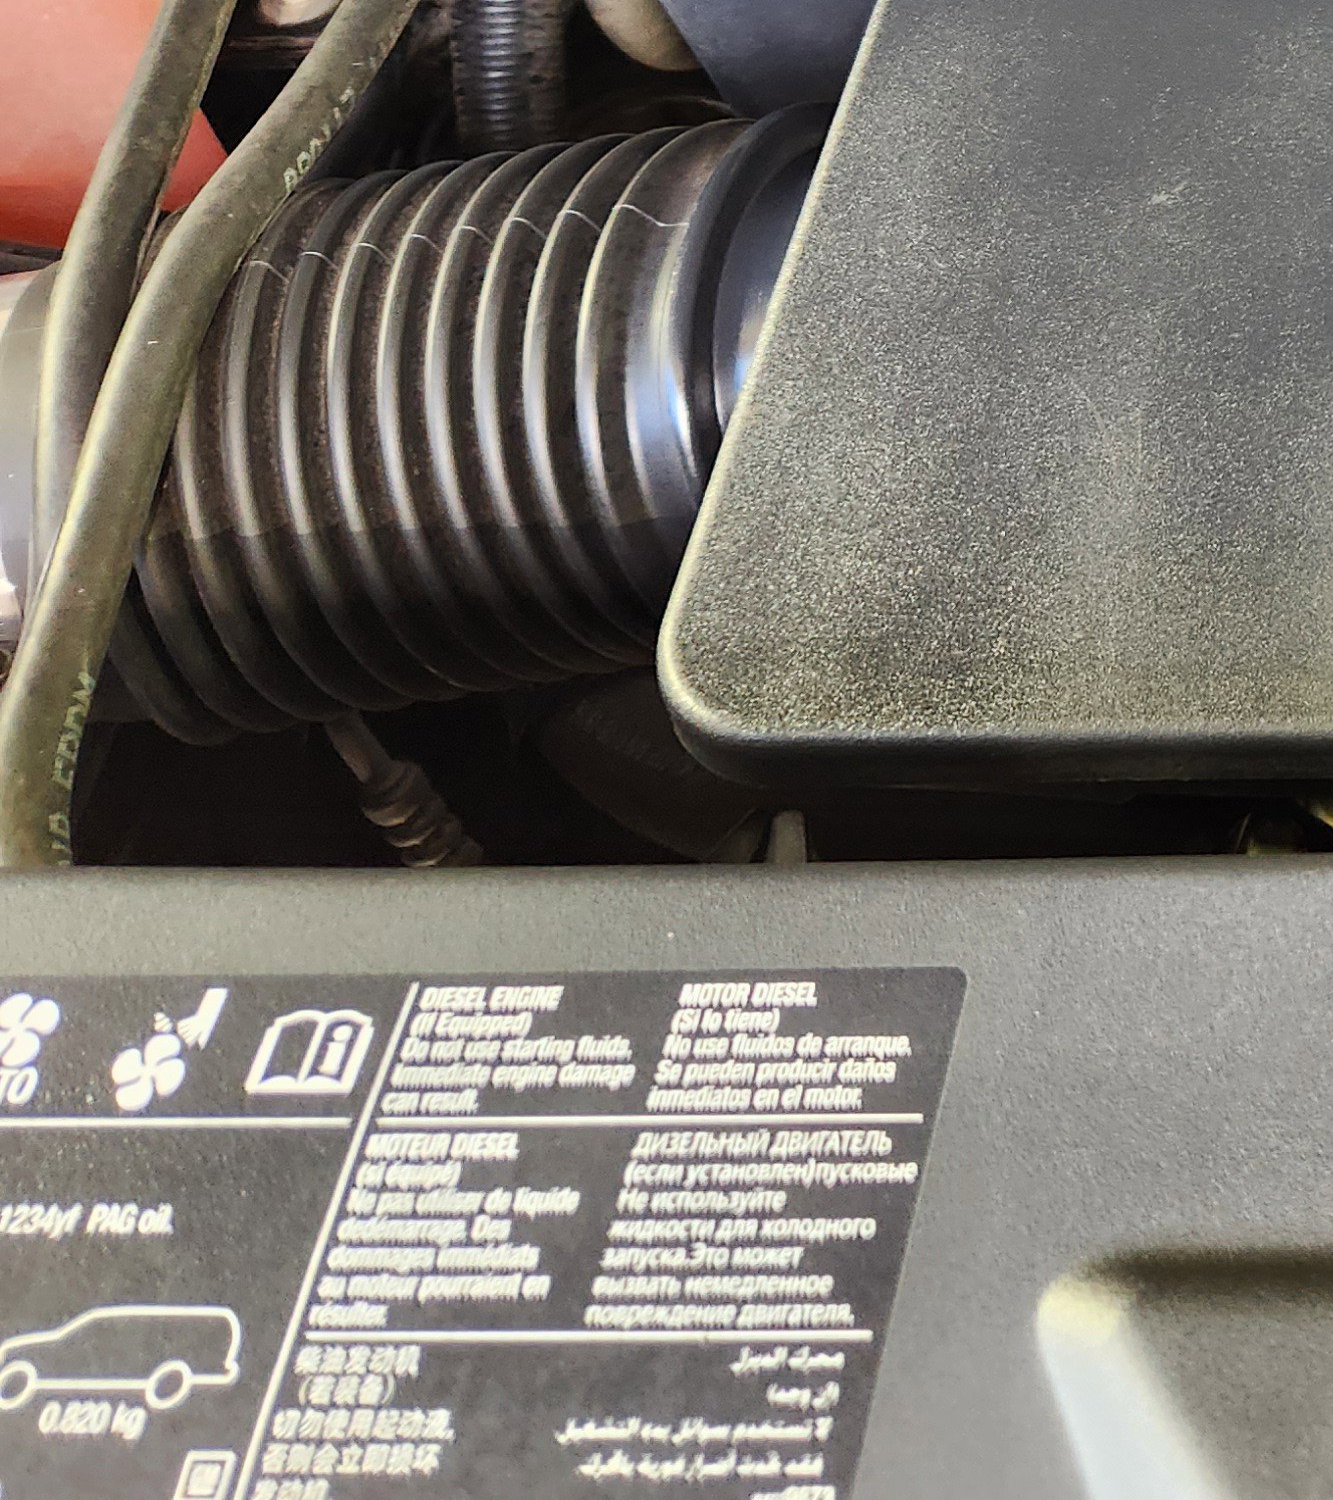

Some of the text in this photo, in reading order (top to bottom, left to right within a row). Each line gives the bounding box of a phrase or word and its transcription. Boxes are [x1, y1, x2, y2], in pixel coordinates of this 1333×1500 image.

[419, 985, 564, 1011] DIESEL ENGINE
[679, 982, 818, 1007] MOTOR DIESEL
[434, 1011, 533, 1038] Equipped)
[400, 1036, 430, 1062] Do
[429, 1037, 465, 1062] not
[464, 1040, 501, 1062] use
[501, 1035, 575, 1064] starting
[663, 1033, 692, 1059] No
[692, 1036, 730, 1059] use
[730, 1033, 795, 1058] fluidos
[797, 1033, 823, 1057] de
[390, 1061, 636, 1092] Immediate engine damage
[654, 1058, 897, 1088] Se pueden producir daños
[381, 1091, 420, 1115] can
[646, 1086, 752, 1112] inmediatos
[752, 1088, 780, 1111] en
[781, 1085, 803, 1111] el
[365, 1132, 520, 1160] MOTEUR DIESEL
[631, 1129, 893, 1158] ДИЗЕЛЬНЫЙ ДВИГАТЕЛЬ
[86, 1202, 138, 1235] PAG
[39, 1401, 147, 1441] 0.820 kg
